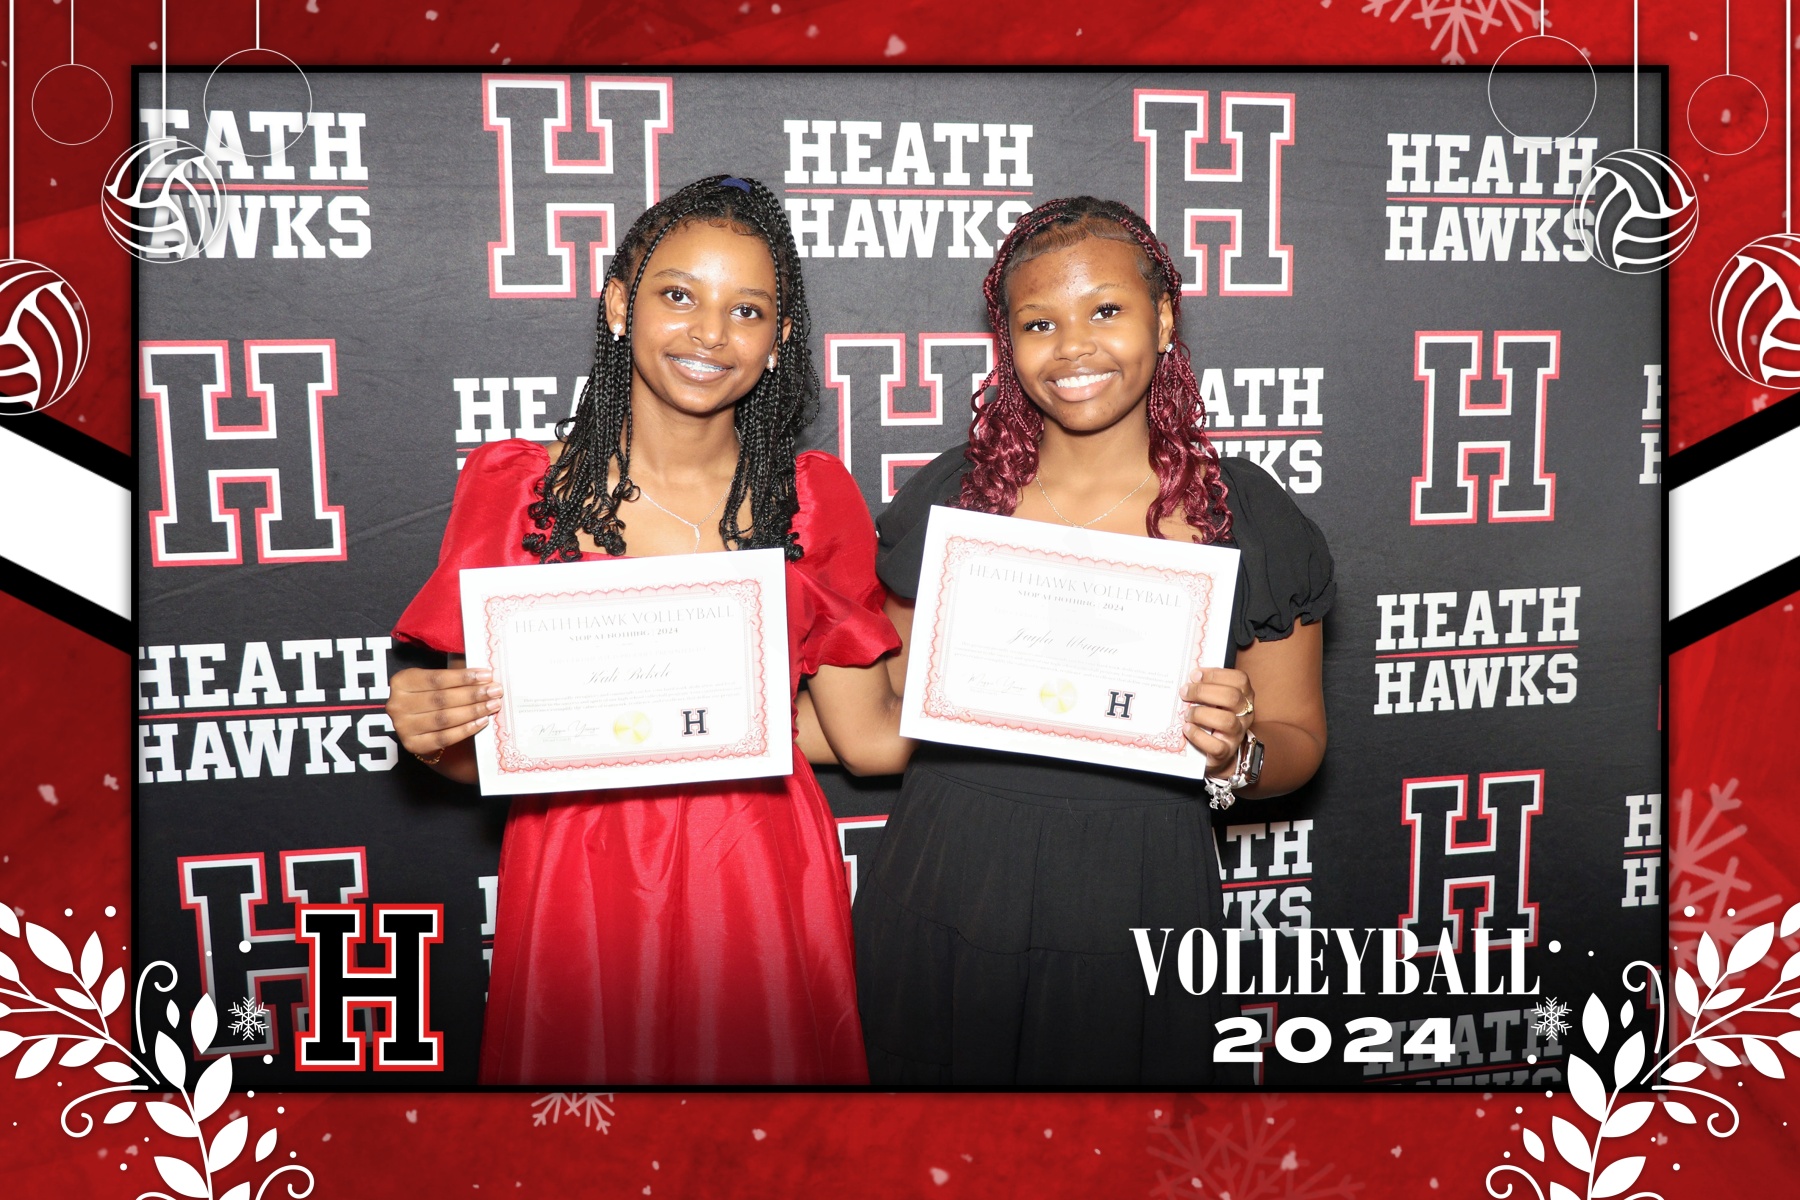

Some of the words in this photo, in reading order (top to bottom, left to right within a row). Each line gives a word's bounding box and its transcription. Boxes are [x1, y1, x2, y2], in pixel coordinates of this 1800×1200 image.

[139, 108, 369, 180] EATH
[783, 119, 1034, 187] HEATH
[1386, 133, 1598, 195] HEATH
[482, 74, 673, 299] H
[1133, 88, 1296, 297] H
[146, 195, 372, 258] AWKS
[1384, 205, 1596, 262] HAWKS
[1192, 367, 1324, 428] ATH
[1410, 330, 1562, 526] H
[139, 339, 348, 567] H
[969, 563, 1023, 585] HEATH
[1028, 572, 1077, 593] HAWK
[1083, 581, 1182, 608] VOLLEYBALL
[1102, 602, 1125, 612] 2024
[515, 617, 571, 634] HEATH
[578, 613, 628, 630] HAWK
[632, 605, 734, 625] VOLLEYBALL
[657, 627, 679, 636] 2024
[1375, 586, 1581, 651] HEATH
[139, 636, 392, 711] HEATH
[1104, 688, 1136, 721] H
[1373, 653, 1578, 716] HAWKS
[139, 713, 399, 784] HAWKS
[680, 706, 710, 738] H
[1398, 768, 1545, 958] H
